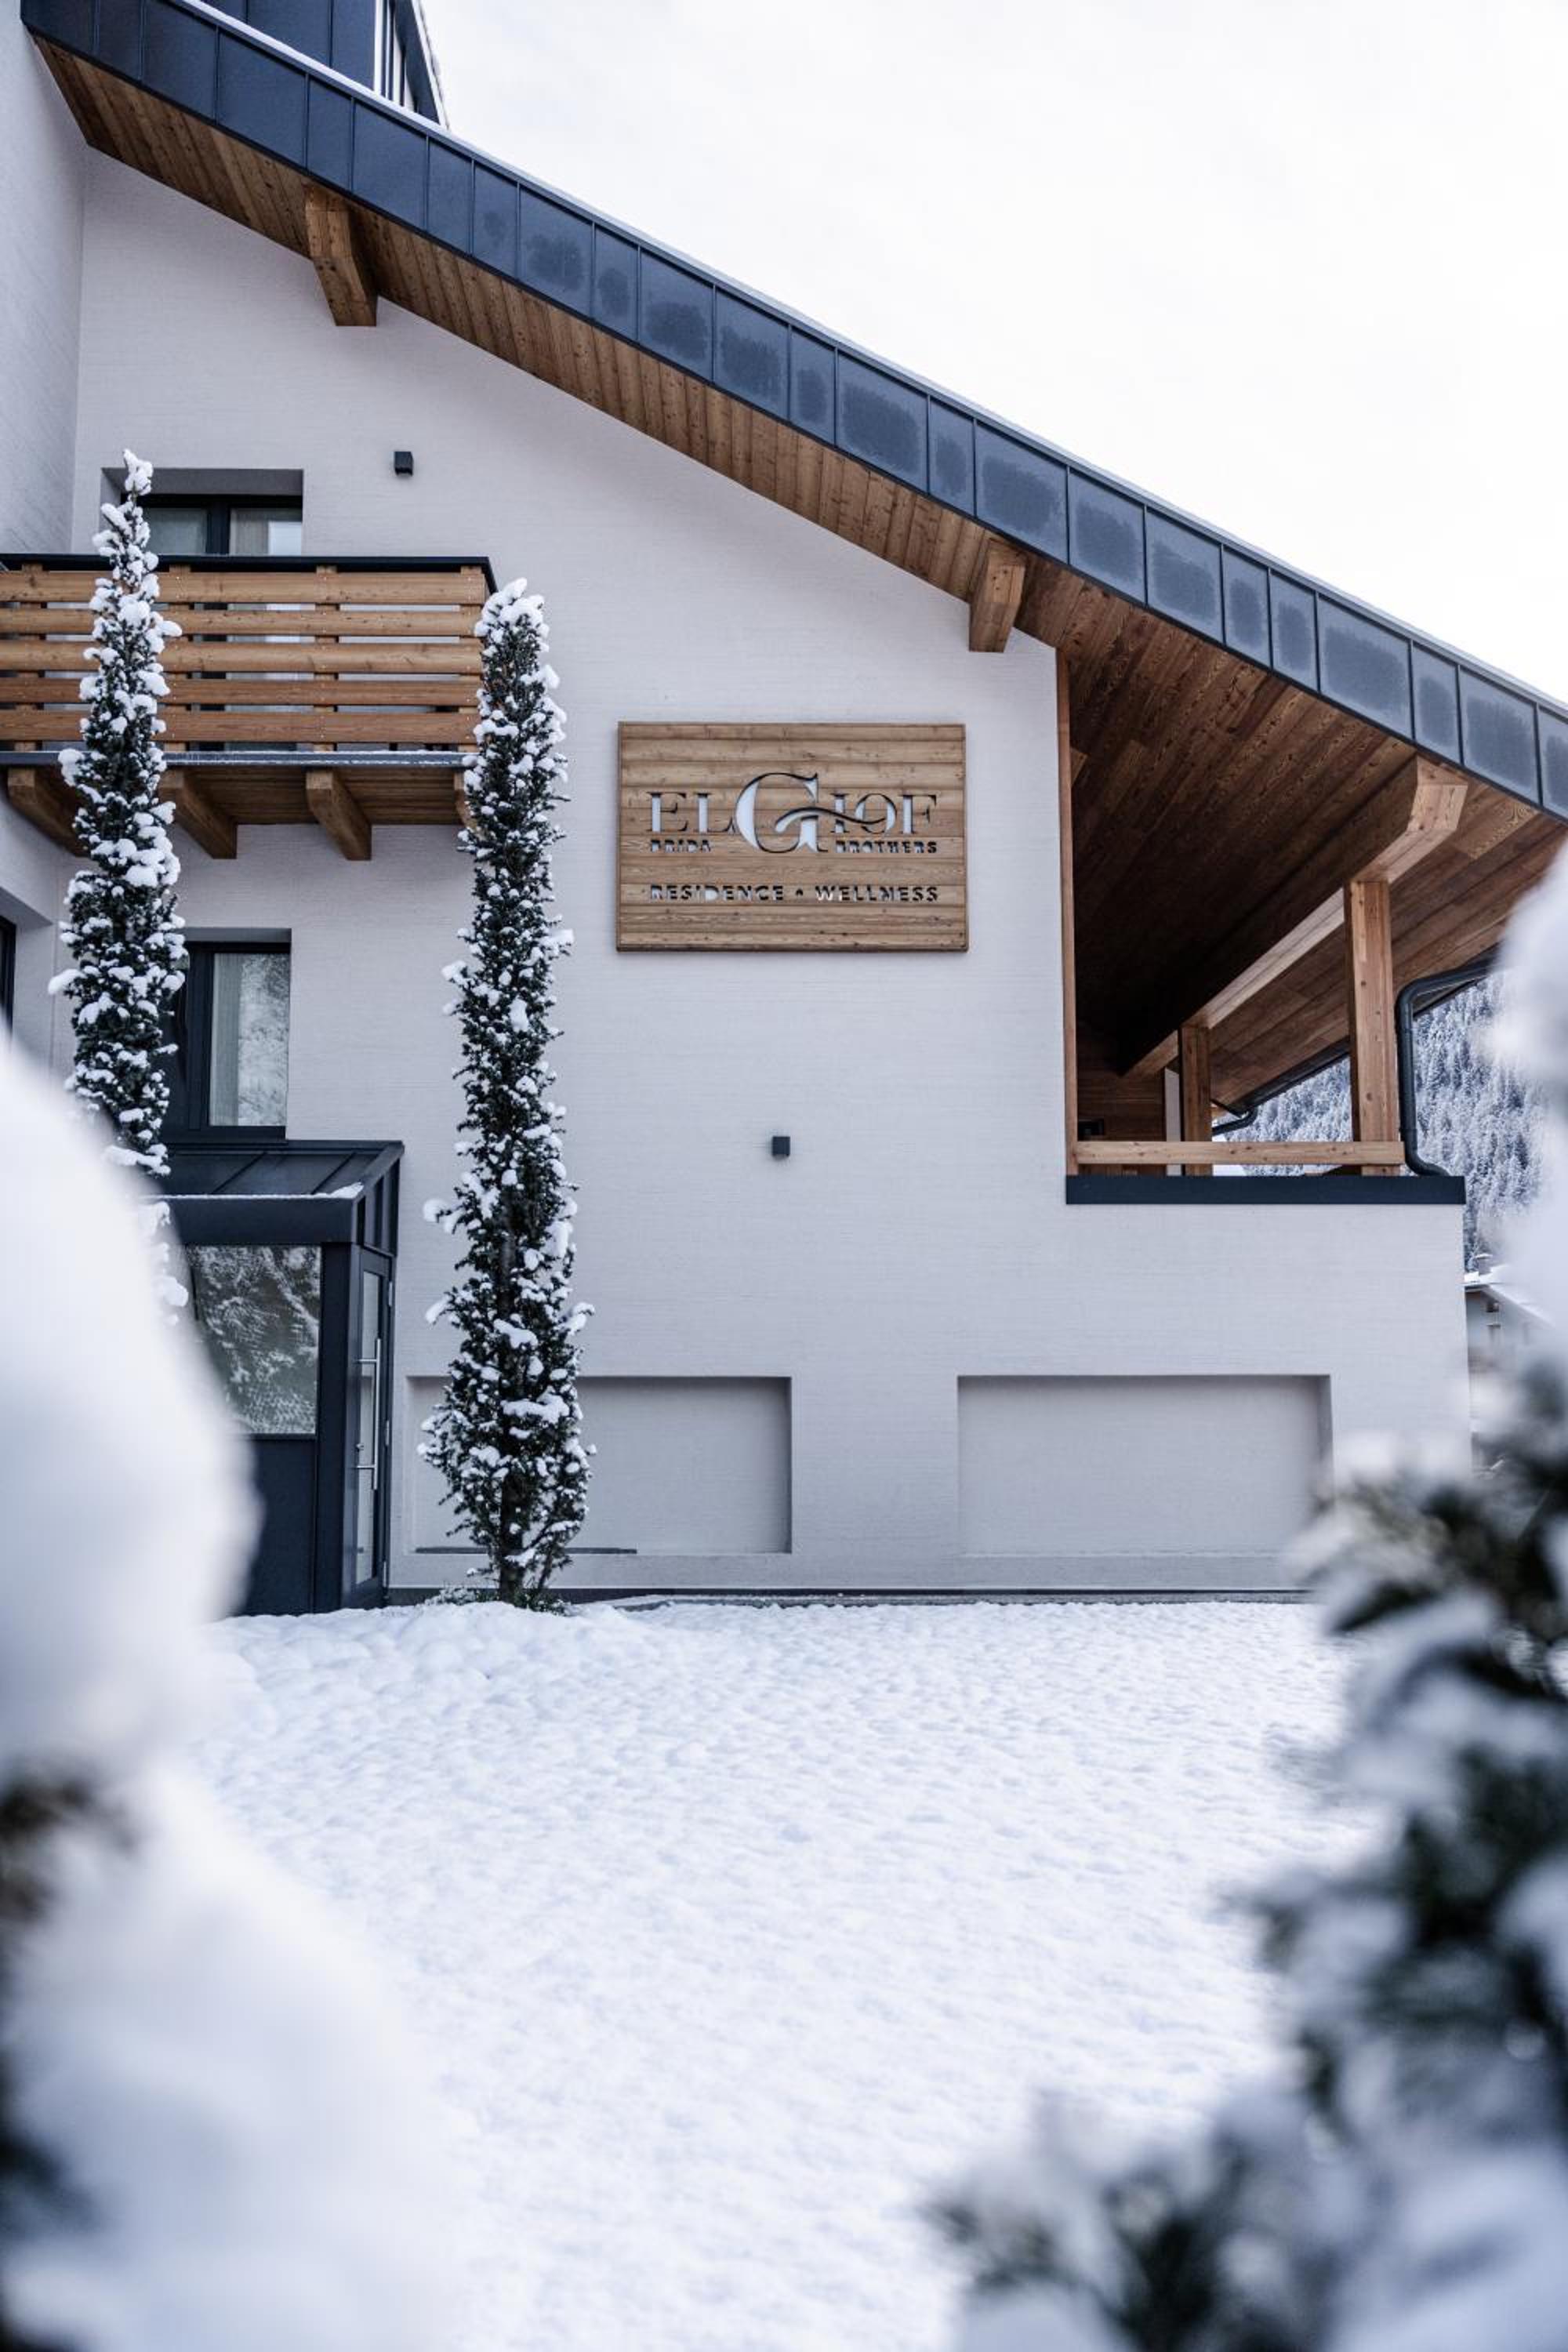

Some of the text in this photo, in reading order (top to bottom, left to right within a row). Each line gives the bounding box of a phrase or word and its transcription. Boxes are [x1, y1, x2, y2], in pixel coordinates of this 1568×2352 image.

[836, 840, 938, 854] BROTHERS
[651, 885, 938, 902] RESIDENCE WELLNESS
